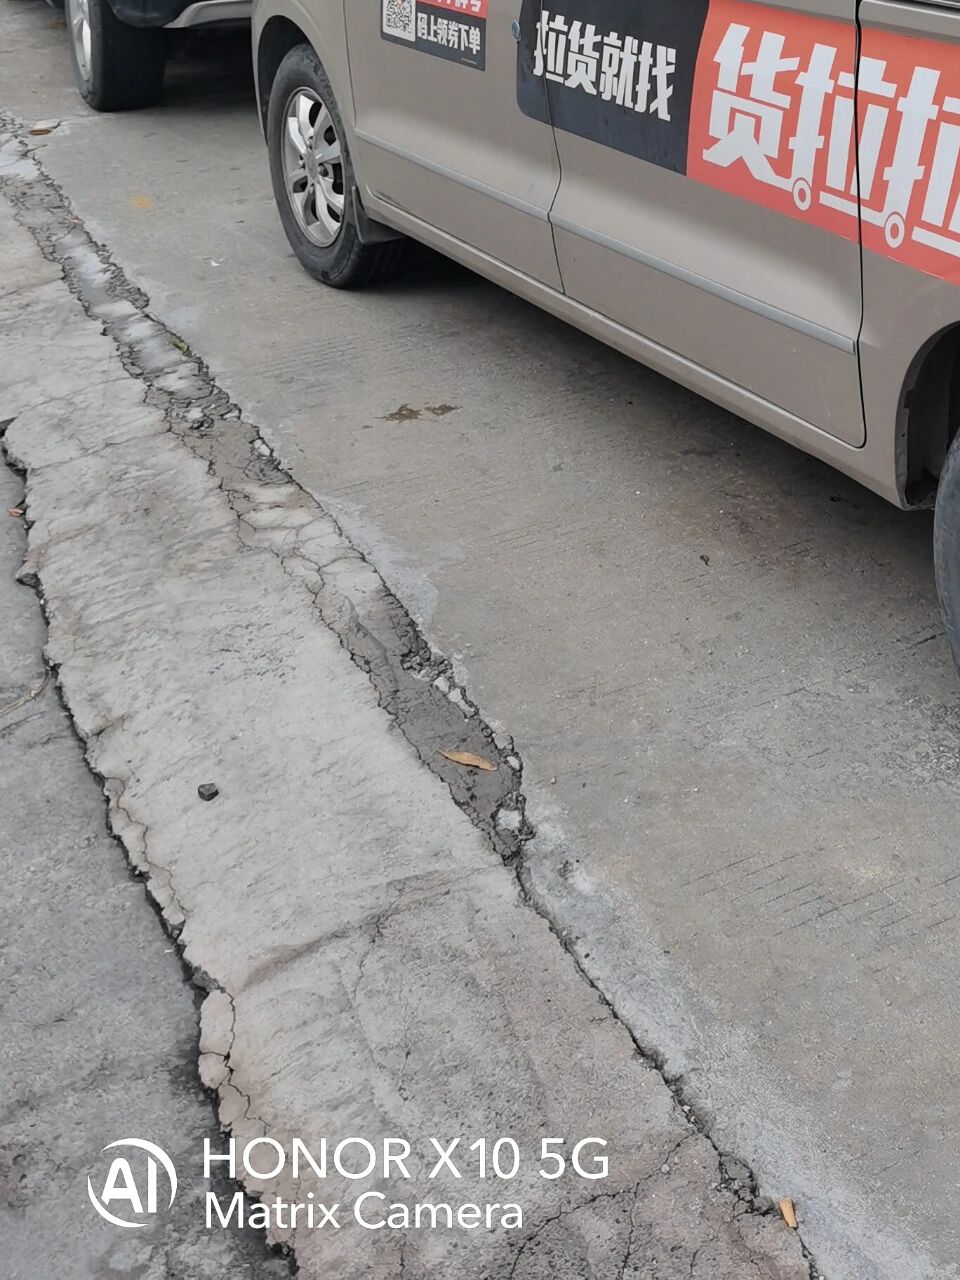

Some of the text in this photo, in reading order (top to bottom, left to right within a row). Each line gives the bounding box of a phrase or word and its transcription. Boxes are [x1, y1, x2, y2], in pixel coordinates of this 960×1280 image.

[417, 13, 481, 55] 码上领券下单
[532, 9, 677, 122] 拉货就找
